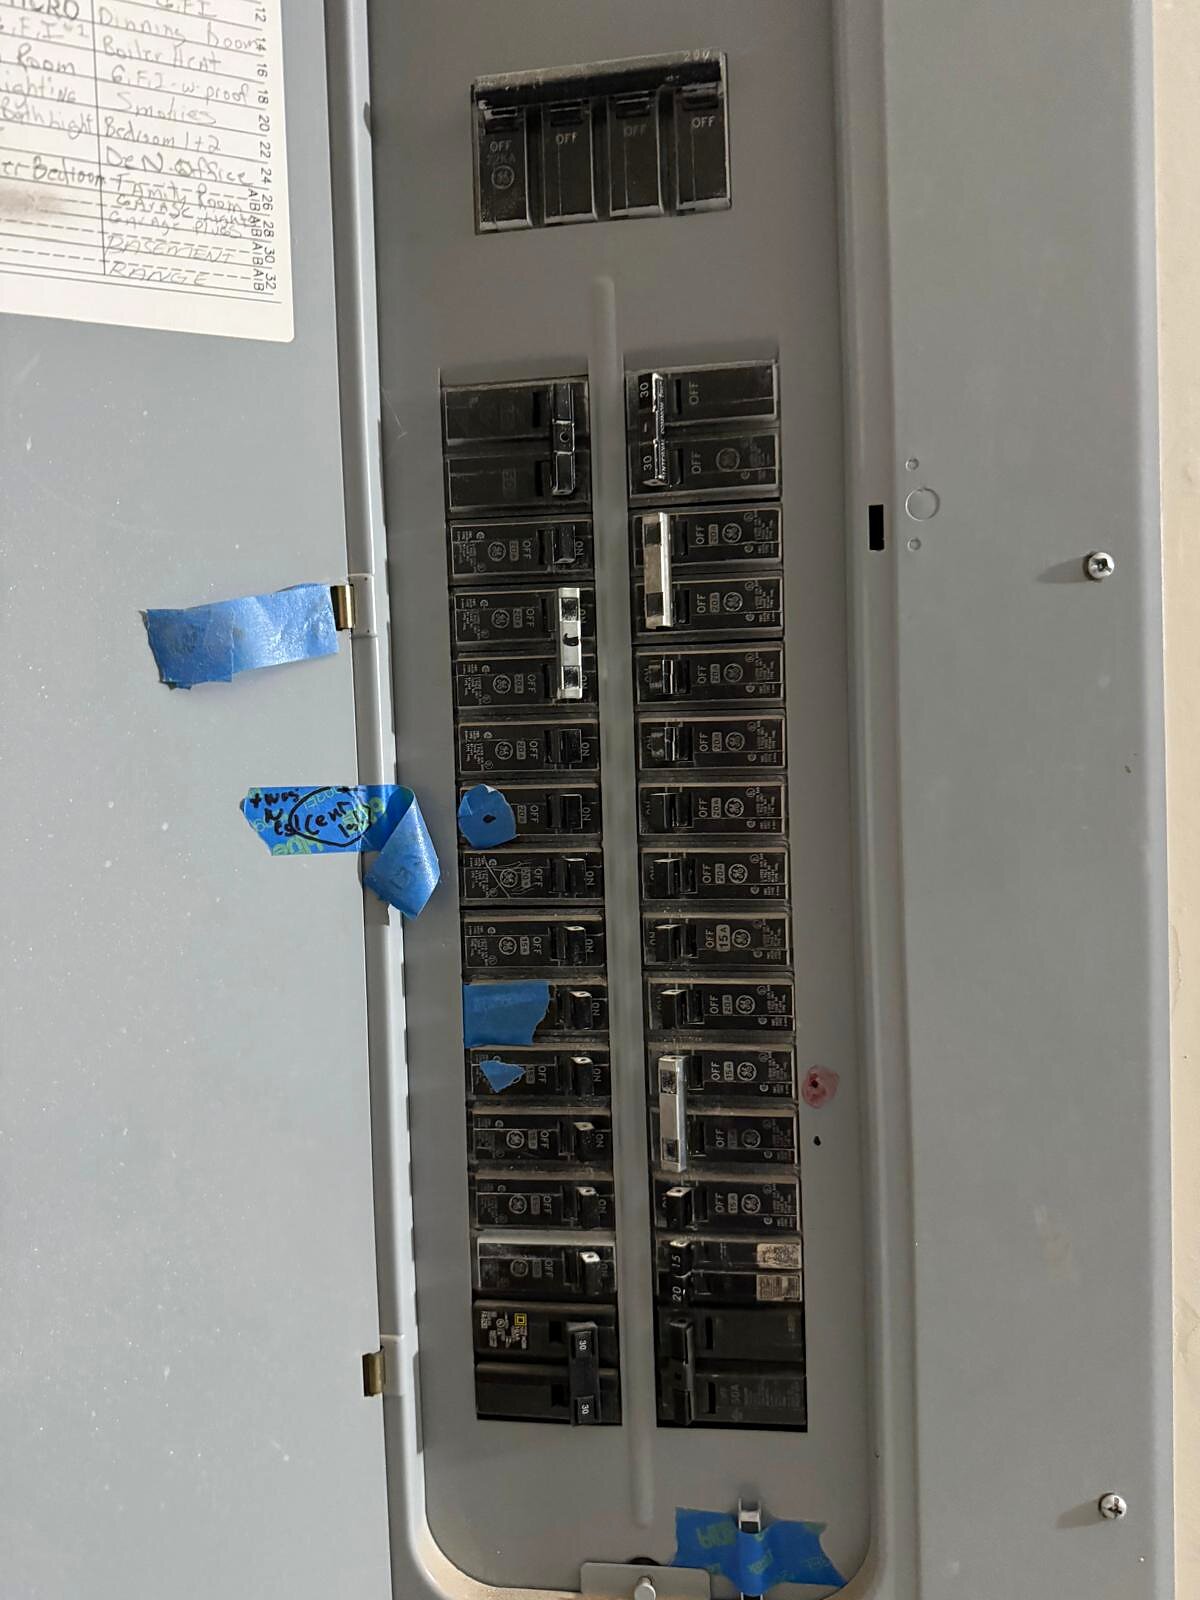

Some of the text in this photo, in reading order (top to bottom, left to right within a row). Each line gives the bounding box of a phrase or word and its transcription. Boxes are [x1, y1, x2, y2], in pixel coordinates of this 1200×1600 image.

[255, 8, 267, 22] 12
[257, 63, 269, 78] 16
[258, 90, 270, 104] 18
[259, 115, 271, 132] 20
[623, 124, 647, 137] OFF
[691, 115, 716, 129] OFF
[489, 140, 512, 152] OFF
[555, 132, 579, 145] OFF
[260, 141, 272, 158] 22
[261, 167, 272, 184] 24
[262, 194, 274, 211] 26
[263, 221, 275, 238] 28
[264, 247, 276, 264] 30
[110, 260, 208, 286] RANGE
[265, 274, 277, 290] 32
[639, 382, 649, 398] 30
[688, 381, 700, 405] OFF
[642, 454, 653, 471] 30
[691, 451, 702, 475] OFF
[696, 526, 705, 545] OFF
[522, 540, 532, 559] OFF
[575, 540, 584, 557] ON
[697, 594, 706, 614] OFF
[525, 608, 535, 628] OFF
[697, 665, 707, 684] OFF
[527, 674, 537, 694] OFF
[529, 740, 539, 760] OFF
[581, 741, 591, 757] ON
[699, 733, 708, 752] OFF
[529, 804, 539, 824] OFF
[582, 806, 592, 822] ON
[698, 798, 708, 818] OFF
[534, 868, 543, 887] OFF
[585, 870, 595, 886] ON
[702, 864, 712, 884] OFF
[532, 936, 542, 955] OFF
[585, 937, 594, 953] ON
[705, 929, 715, 948] OFF
[592, 1002, 600, 1016] ON
[709, 995, 719, 1014] OFF
[538, 1065, 547, 1085] OFF
[592, 1067, 602, 1083] ON
[710, 1061, 720, 1080] OFF
[540, 1130, 550, 1149] OFF
[595, 1133, 605, 1148] ON
[715, 1129, 725, 1148] OFF
[543, 1195, 552, 1215] OFF
[599, 1198, 608, 1214] ON
[714, 1193, 724, 1213] OFF
[544, 1258, 554, 1278] OFF
[672, 1254, 681, 1268] 15
[671, 1286, 682, 1302] 20
[579, 1339, 587, 1351] 30
[581, 1403, 590, 1415] 30
